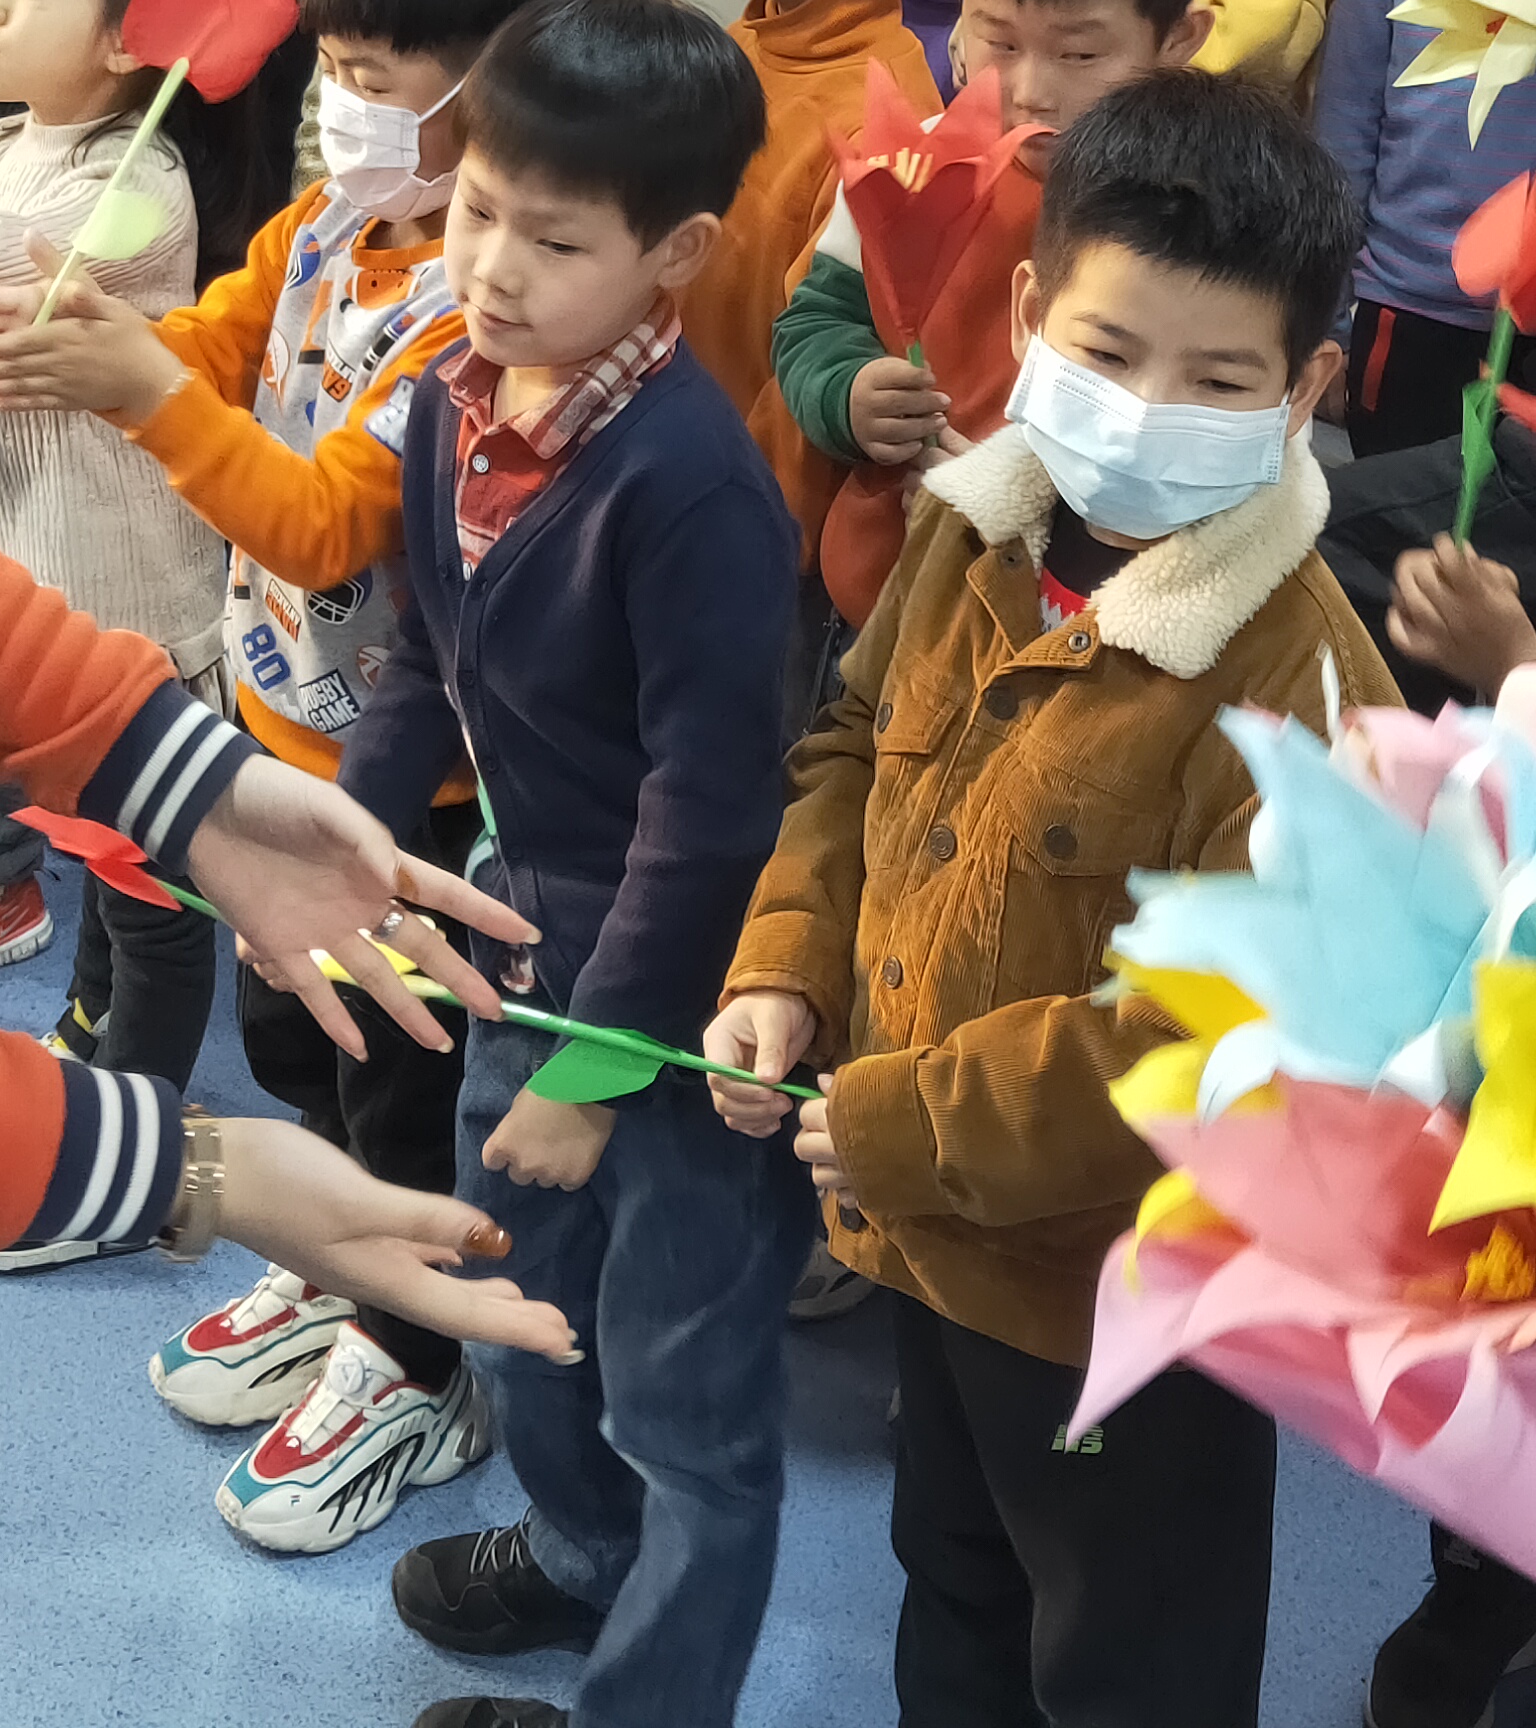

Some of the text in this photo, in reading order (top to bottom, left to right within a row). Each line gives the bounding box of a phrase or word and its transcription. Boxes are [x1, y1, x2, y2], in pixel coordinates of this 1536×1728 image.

[242, 623, 292, 691] 80
[299, 673, 347, 711] RUGBY
[308, 696, 361, 733] GAME
